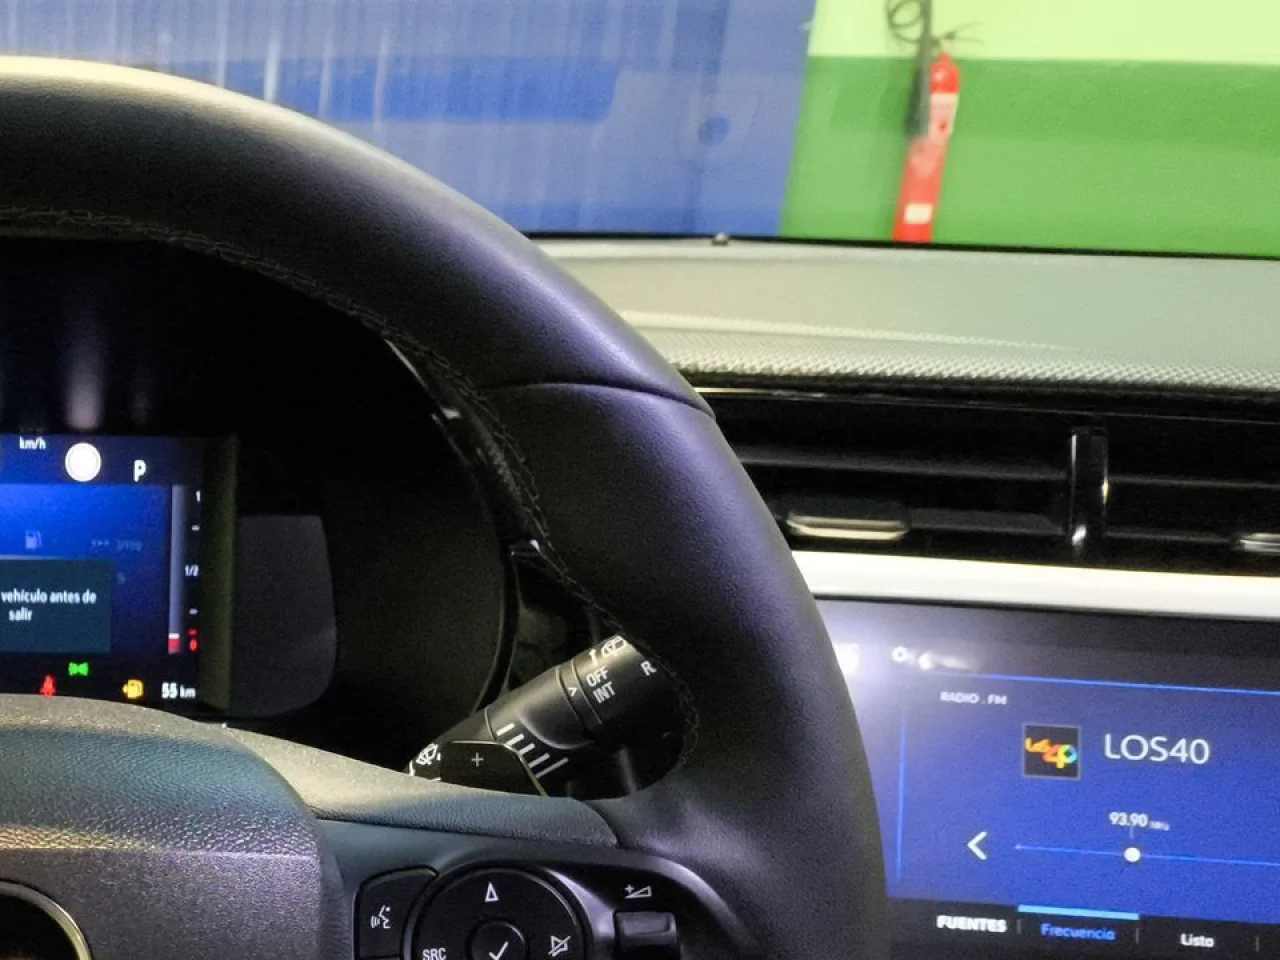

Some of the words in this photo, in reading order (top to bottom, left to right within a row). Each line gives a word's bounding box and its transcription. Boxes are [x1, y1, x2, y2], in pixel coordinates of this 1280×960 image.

[19, 437, 46, 451] km/h
[134, 459, 147, 482] P
[1, 586, 49, 603] vehículo
[50, 589, 80, 604] antes
[82, 588, 97, 604] de
[8, 606, 33, 621] salir
[586, 667, 610, 688] OFF
[161, 682, 178, 699] 55
[179, 684, 197, 699] km
[593, 682, 616, 704] INT
[1104, 733, 1210, 765] LOS40
[1109, 812, 1149, 828] 93.90
[937, 915, 1007, 934] FUENTES
[1040, 922, 1116, 941] Frecuencia
